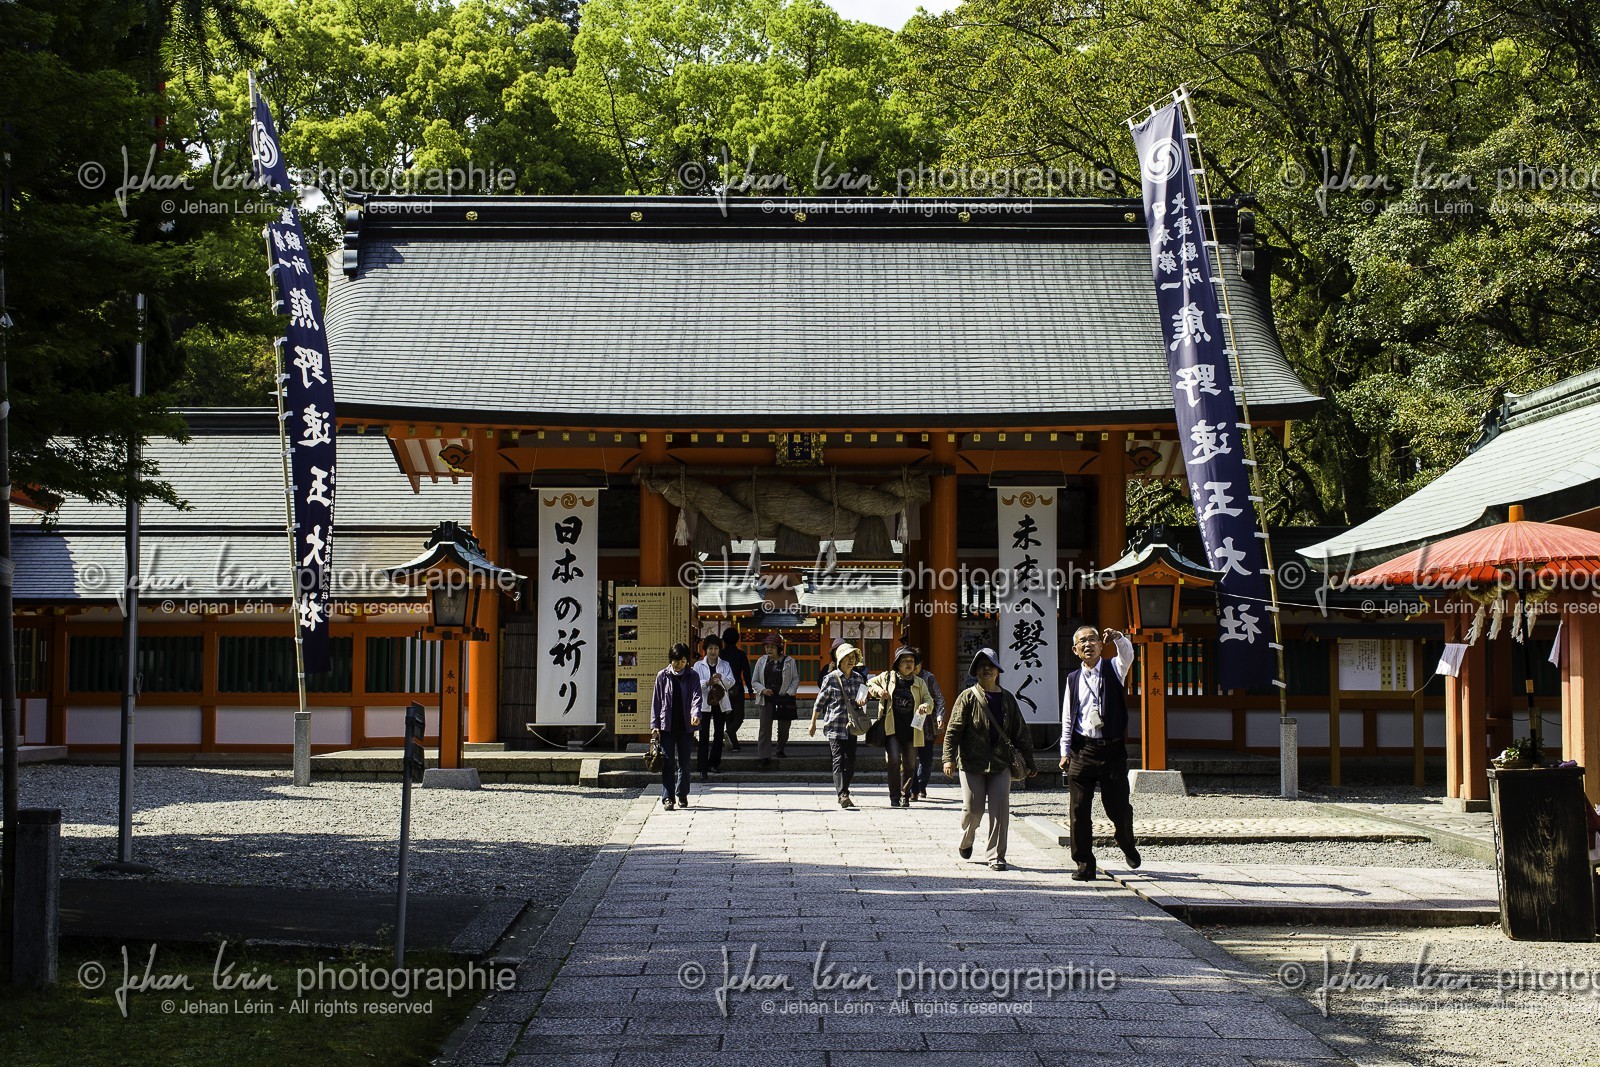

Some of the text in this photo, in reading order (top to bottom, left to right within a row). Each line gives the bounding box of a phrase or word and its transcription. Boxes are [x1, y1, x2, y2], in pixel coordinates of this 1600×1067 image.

[549, 515, 587, 717] 日本の祈り
[1009, 513, 1048, 714] 未来へ繋ぐ
